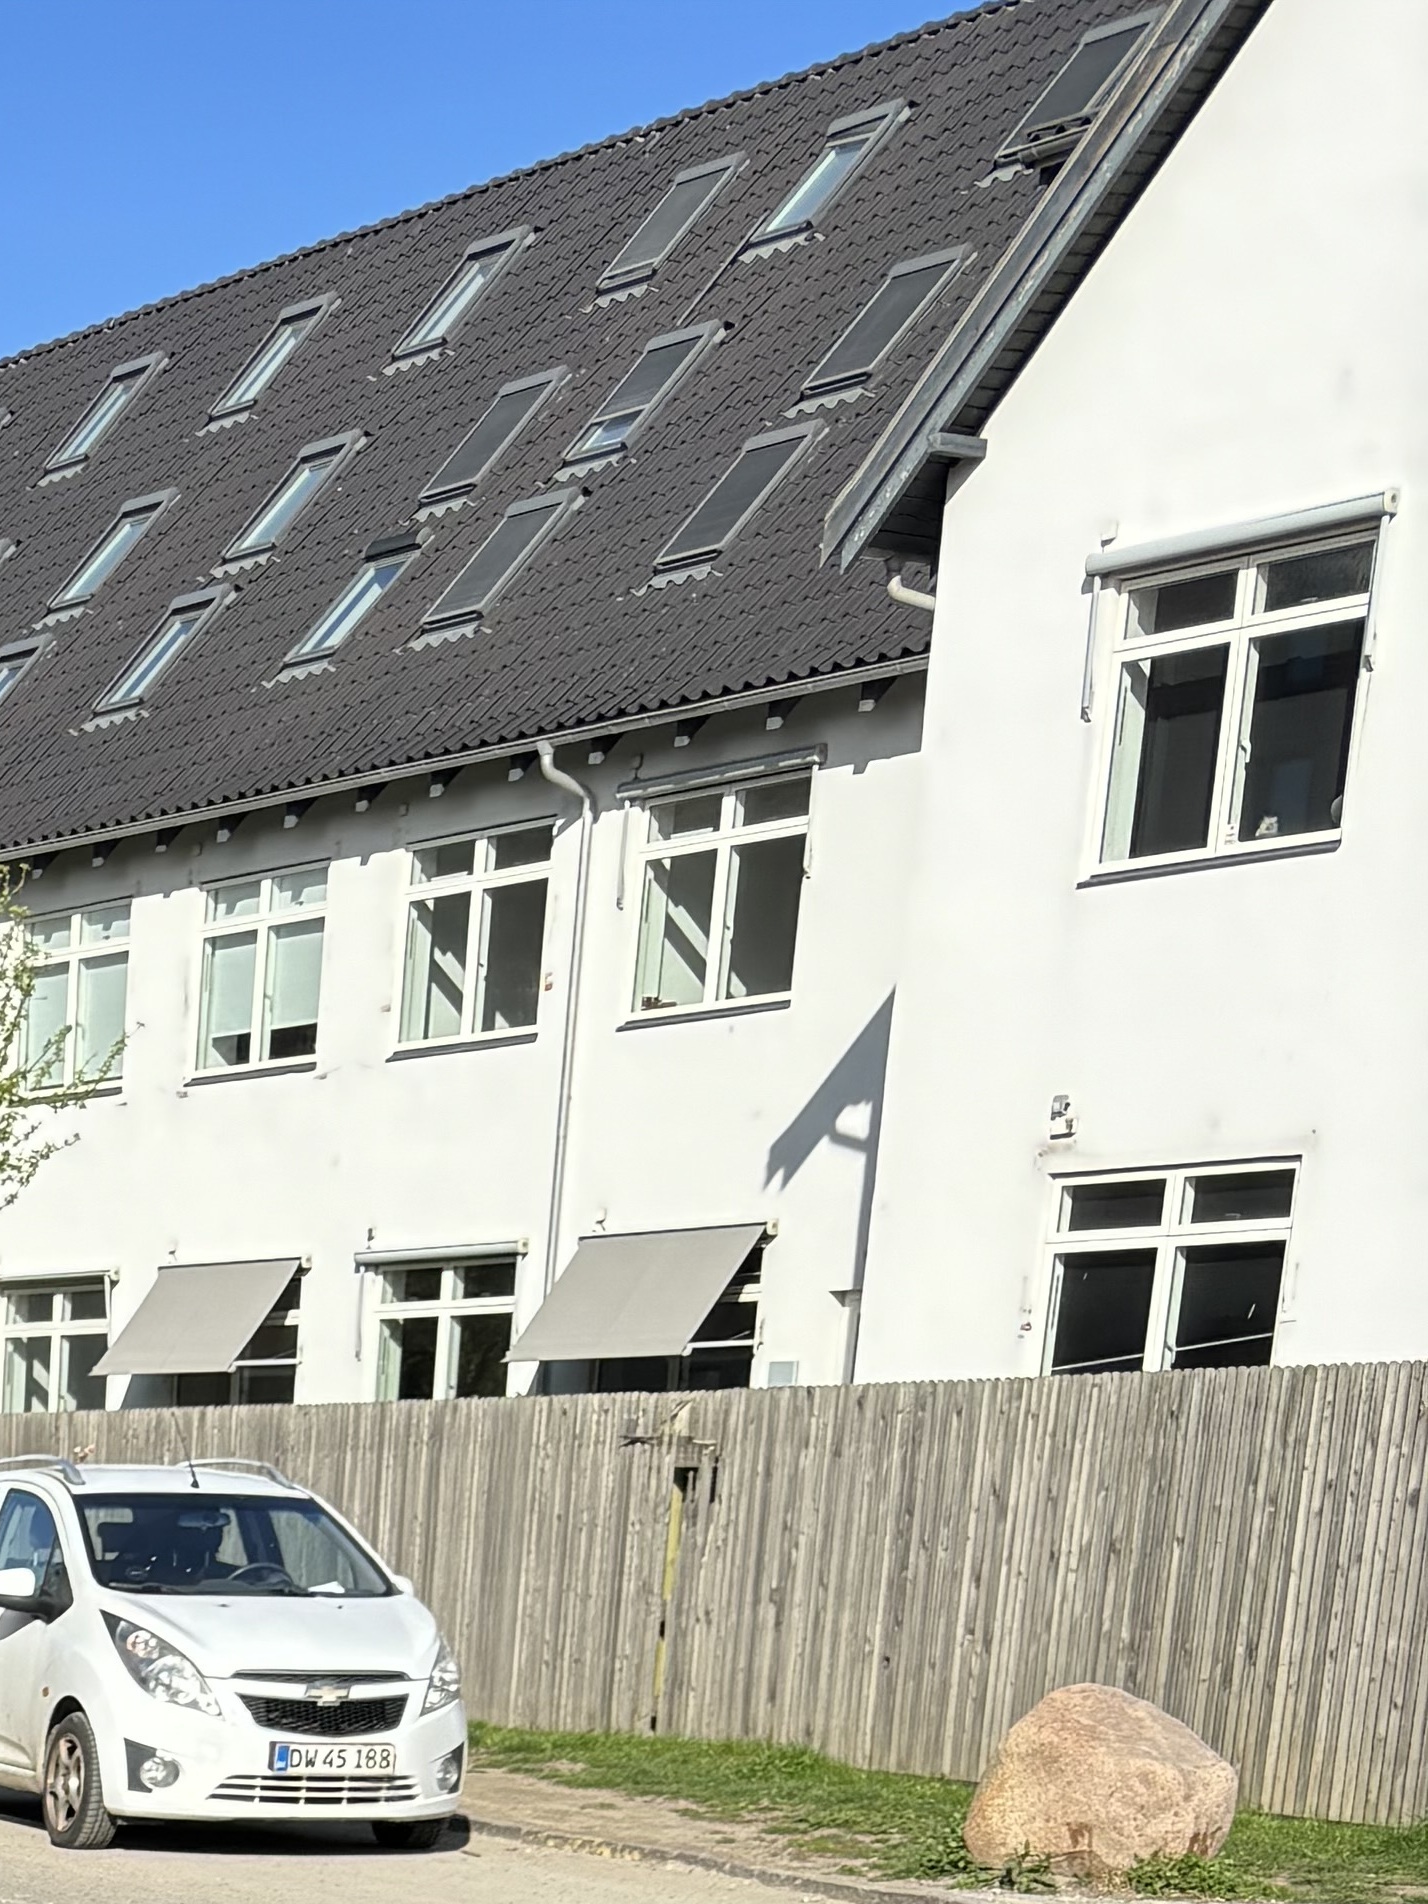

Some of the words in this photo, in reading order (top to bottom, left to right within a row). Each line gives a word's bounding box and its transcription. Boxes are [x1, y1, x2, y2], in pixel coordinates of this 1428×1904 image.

[289, 1748, 319, 1768] DW
[322, 1748, 347, 1769] 45
[354, 1747, 391, 1769] 188
